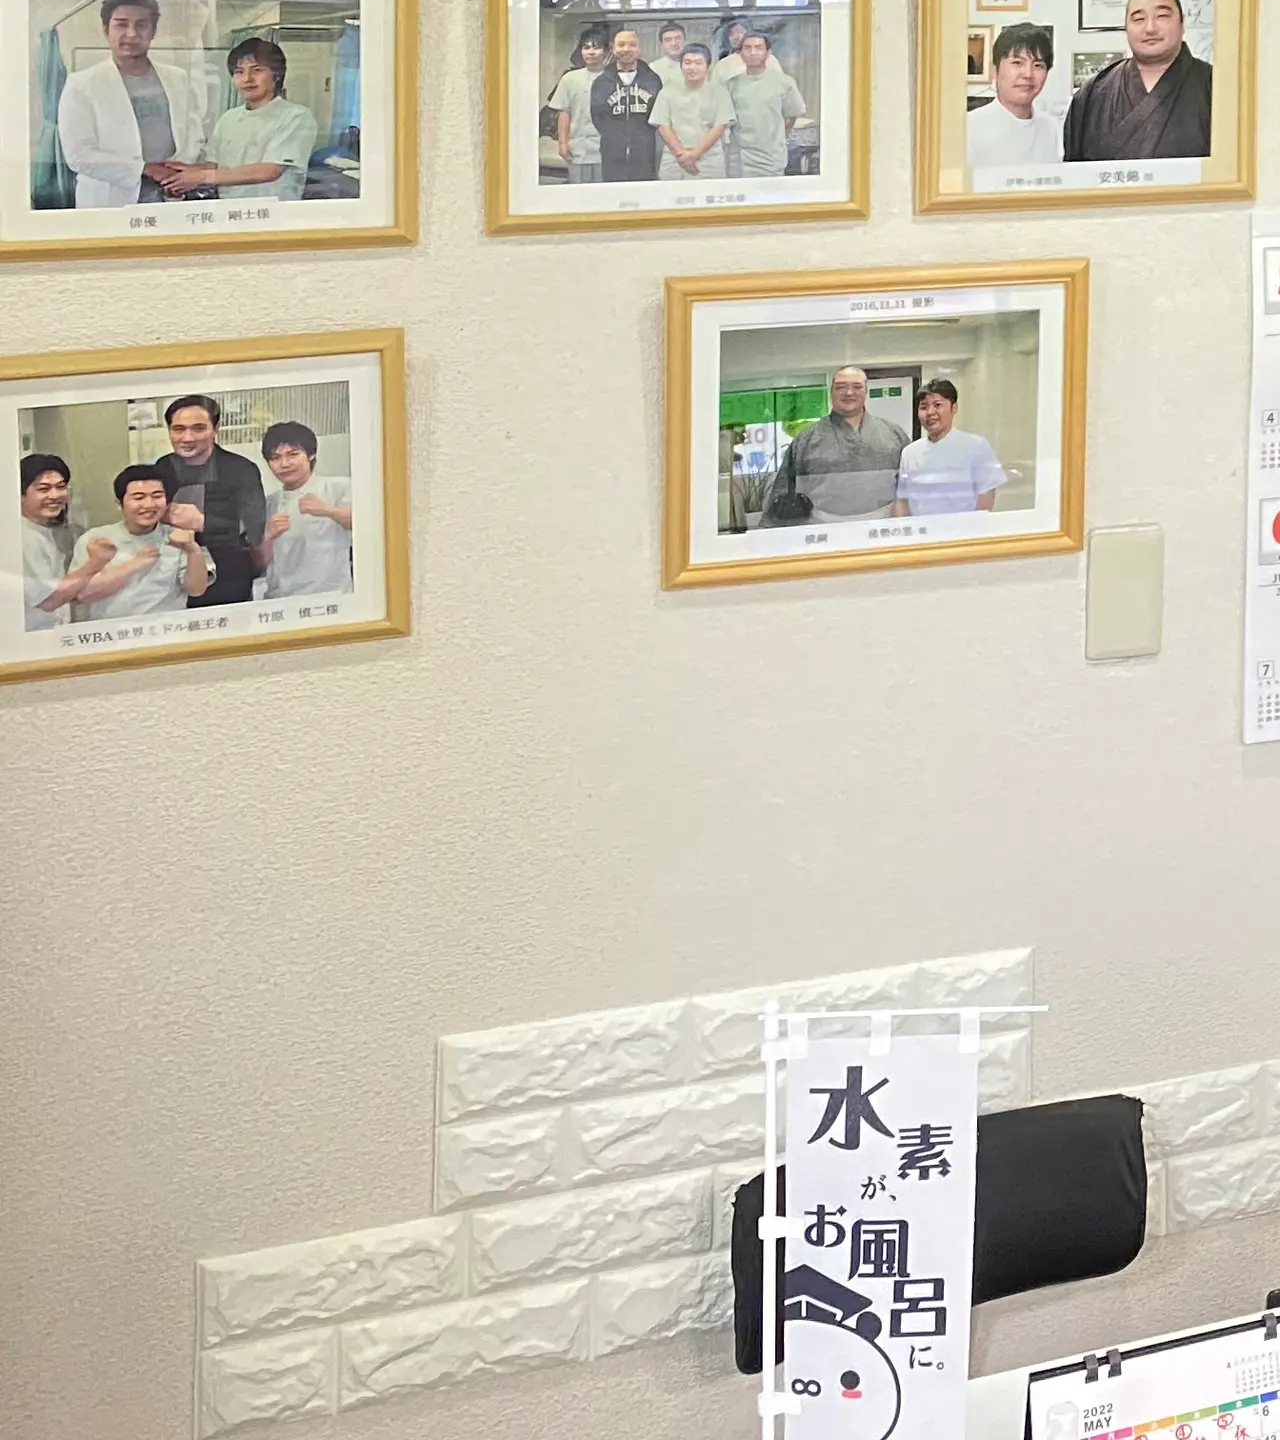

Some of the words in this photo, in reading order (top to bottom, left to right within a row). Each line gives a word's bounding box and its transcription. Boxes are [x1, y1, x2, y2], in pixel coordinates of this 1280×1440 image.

[129, 216, 157, 229] 俳優
[228, 208, 270, 221] 剛士様
[258, 609, 284, 623] 竹原
[1083, 1403, 1114, 1418] 2022
[1262, 1406, 1270, 1417] 6
[1084, 1417, 1113, 1433] MAY
